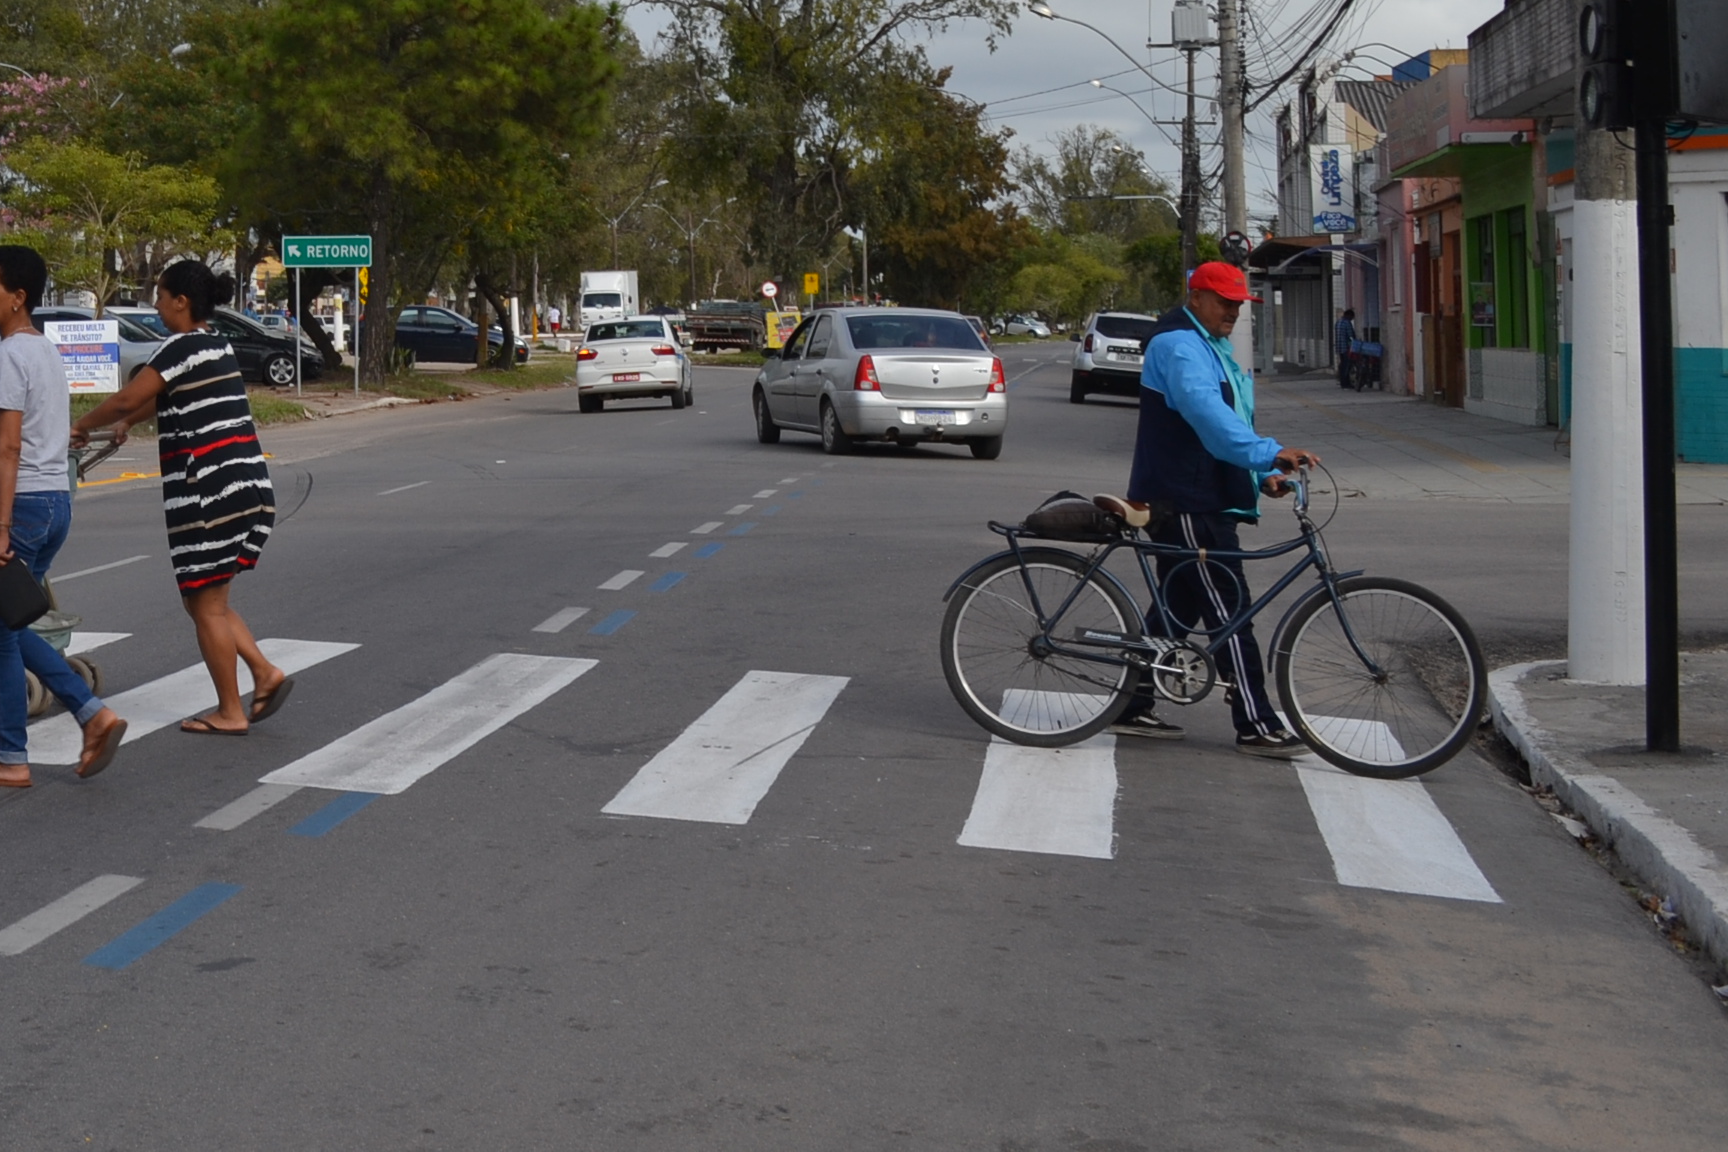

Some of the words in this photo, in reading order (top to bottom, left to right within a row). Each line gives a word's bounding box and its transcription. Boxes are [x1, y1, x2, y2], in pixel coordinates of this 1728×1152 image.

[306, 244, 368, 258] RETORNO
[57, 323, 85, 333] RECEBEU
[85, 323, 106, 332] MULTA
[60, 334, 69, 342] DE
[70, 333, 103, 342] TRÂNSITO?
